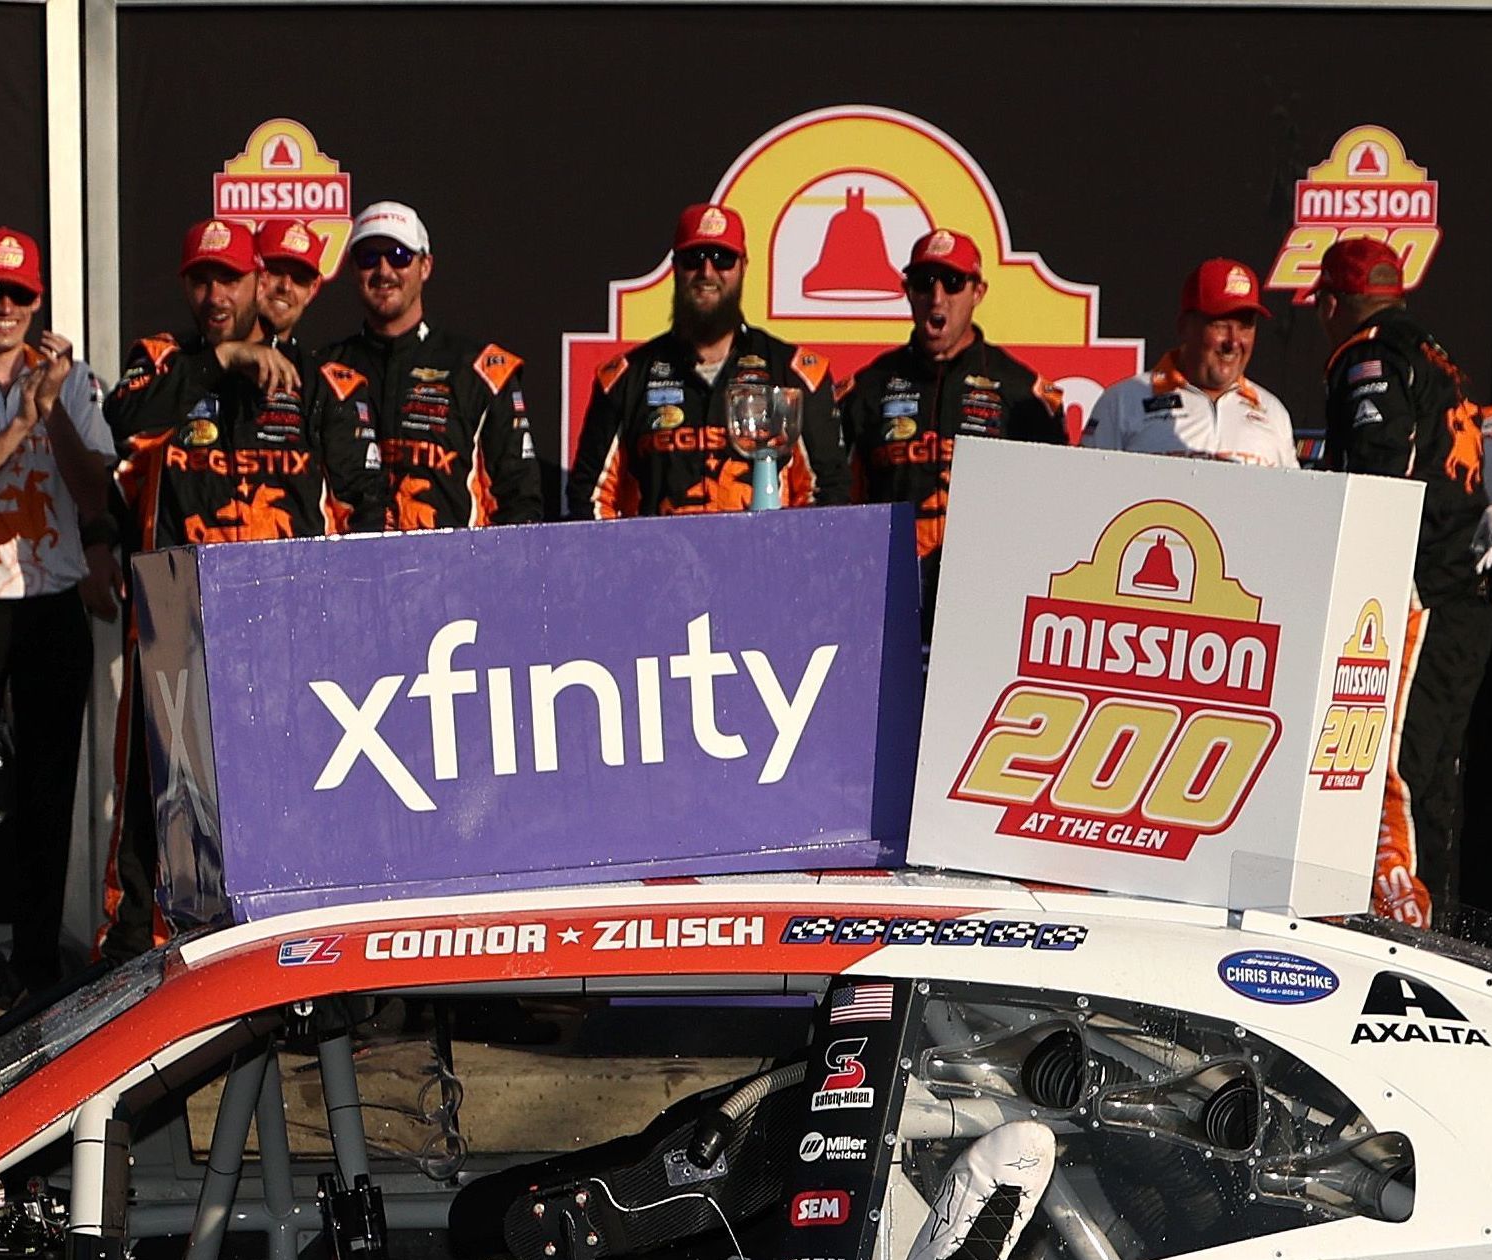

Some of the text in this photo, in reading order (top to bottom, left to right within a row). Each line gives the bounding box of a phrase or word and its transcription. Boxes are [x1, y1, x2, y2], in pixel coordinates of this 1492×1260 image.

[220, 181, 345, 212] MISSION
[1300, 188, 1433, 219] MISSION
[1267, 228, 1441, 289] 20
[1029, 611, 1270, 691] MISSION
[1336, 664, 1388, 697] MISSION
[309, 612, 839, 812] xfinity
[1313, 707, 1387, 773] 200
[958, 686, 1276, 829] 200
[1020, 813, 1170, 851] AT THE GLEN
[365, 916, 765, 961] CONNOR ZILISCH
[1226, 967, 1333, 990] CHRIS RASCHKE
[1351, 1022, 1488, 1048] AXALTA
[826, 1136, 866, 1151] Miller
[826, 1151, 867, 1161] Welders
[798, 1199, 839, 1219] SEM
